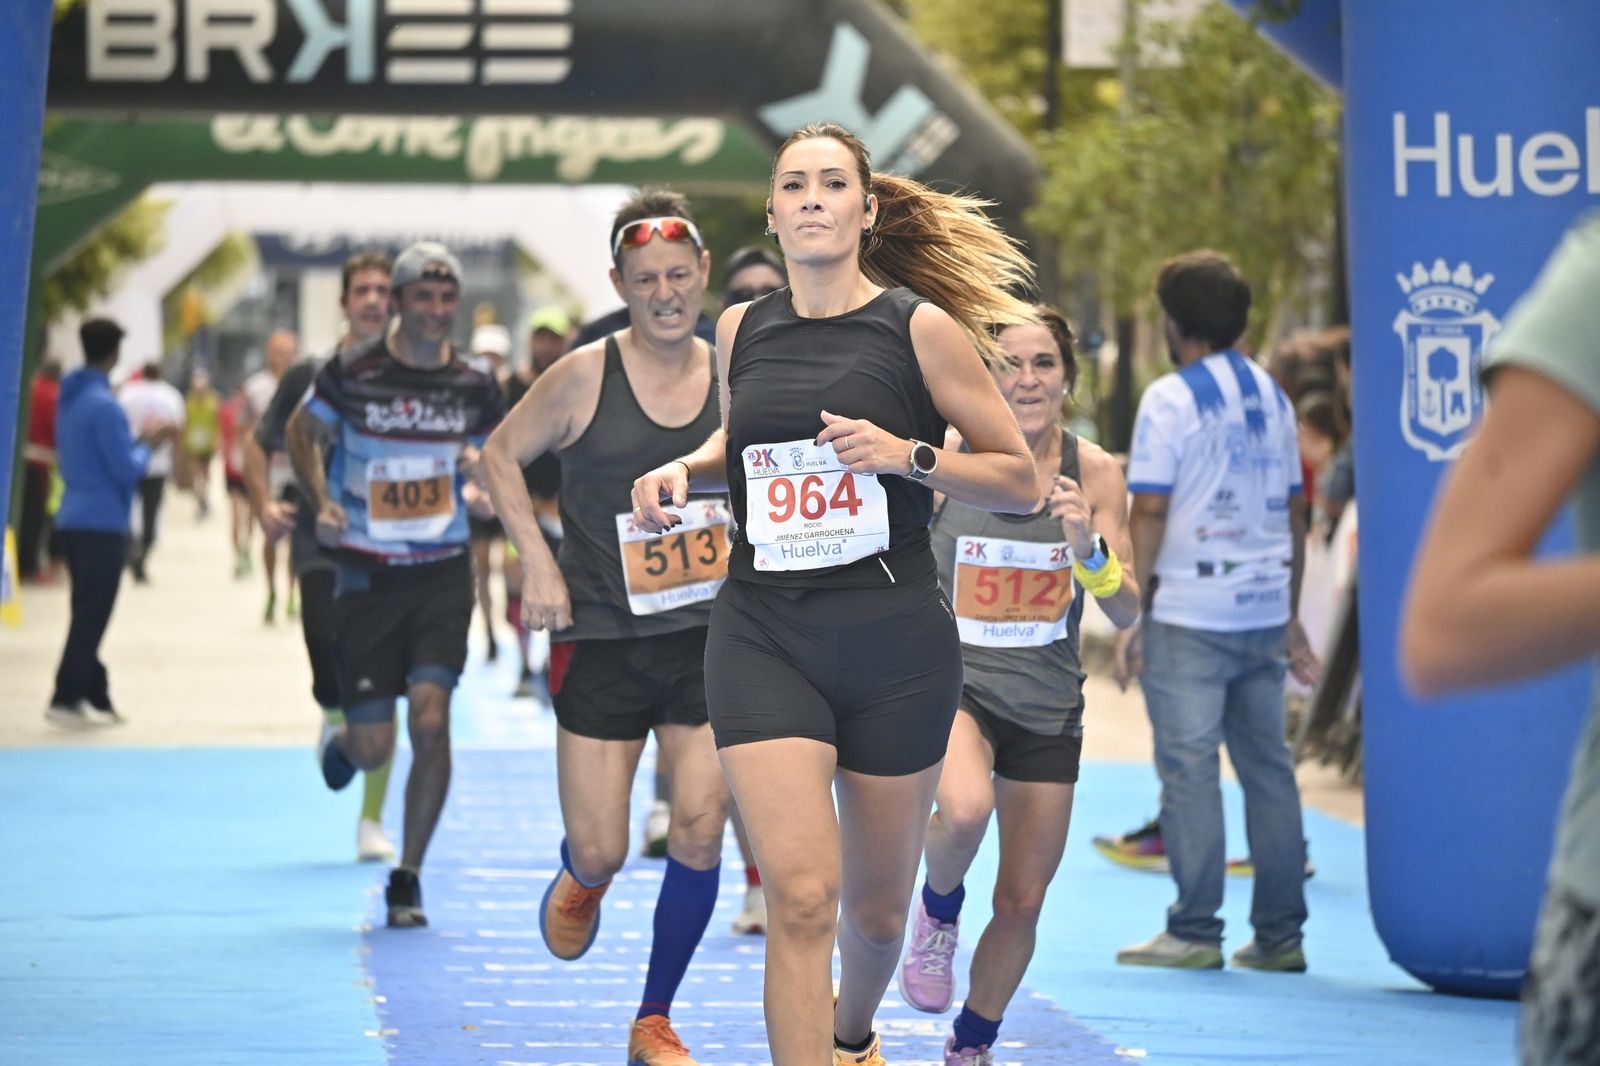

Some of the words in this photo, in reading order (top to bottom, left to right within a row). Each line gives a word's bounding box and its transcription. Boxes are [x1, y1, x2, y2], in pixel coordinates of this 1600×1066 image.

[753, 466, 781, 477] HUELVA
[382, 479, 441, 509] 403
[767, 472, 863, 523] 964
[775, 533, 803, 542] JIMENEZ
[804, 528, 855, 539] GARROCHENA
[645, 529, 717, 576] 513
[781, 541, 843, 559] Huelva
[975, 568, 1057, 606] 512
[983, 623, 1034, 637] Huelva
